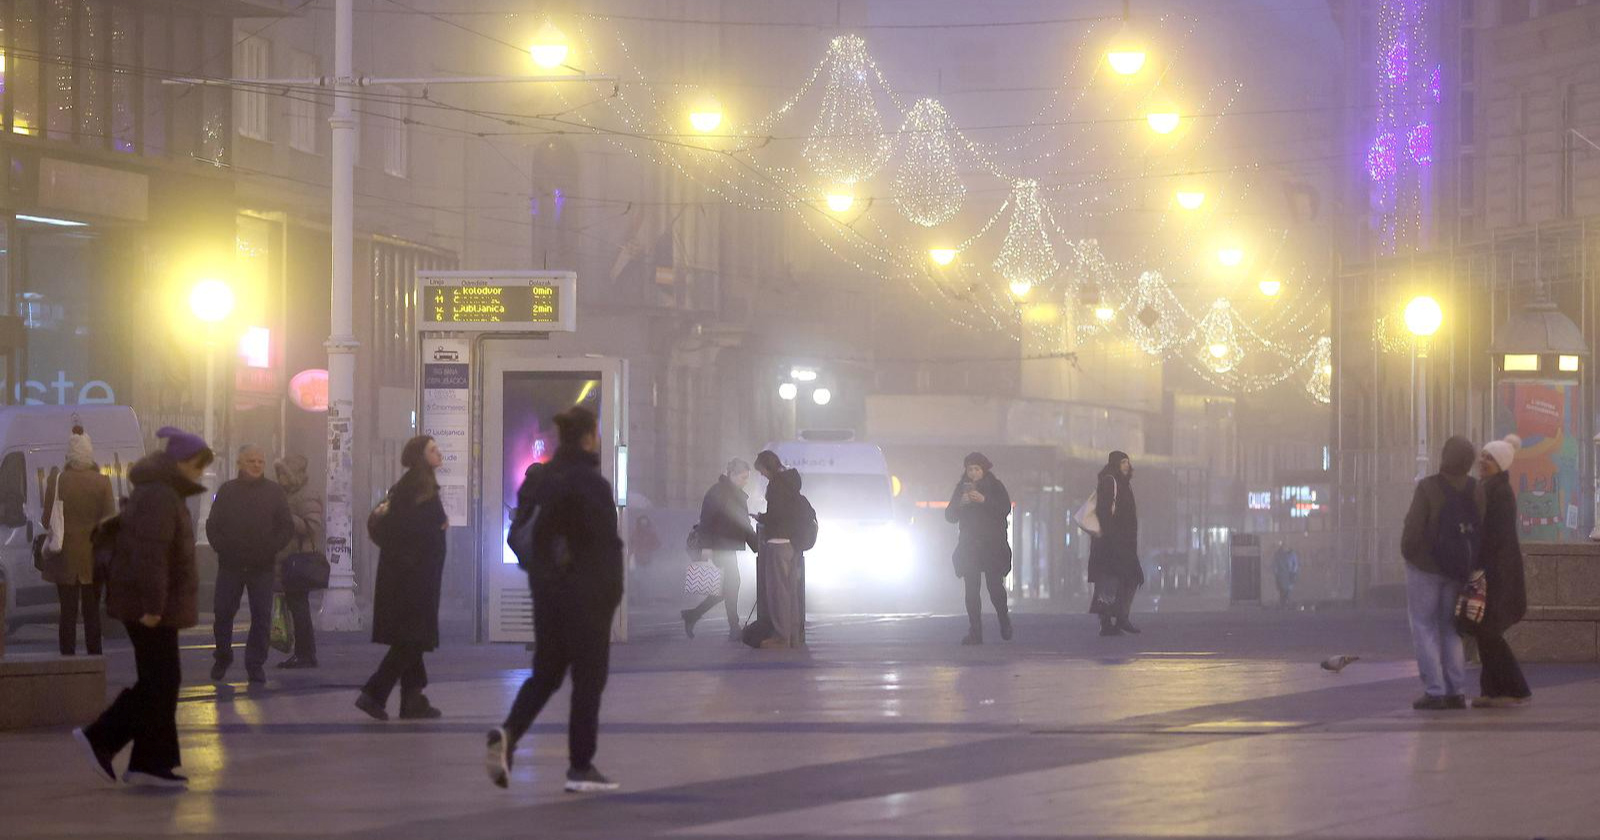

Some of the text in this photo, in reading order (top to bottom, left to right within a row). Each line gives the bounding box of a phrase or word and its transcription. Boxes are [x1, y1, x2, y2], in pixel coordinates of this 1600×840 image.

[462, 287, 502, 295] kolodvor
[532, 287, 552, 295] 0min
[532, 304, 552, 313] 2min
[432, 428, 465, 437] Ljubljanica
